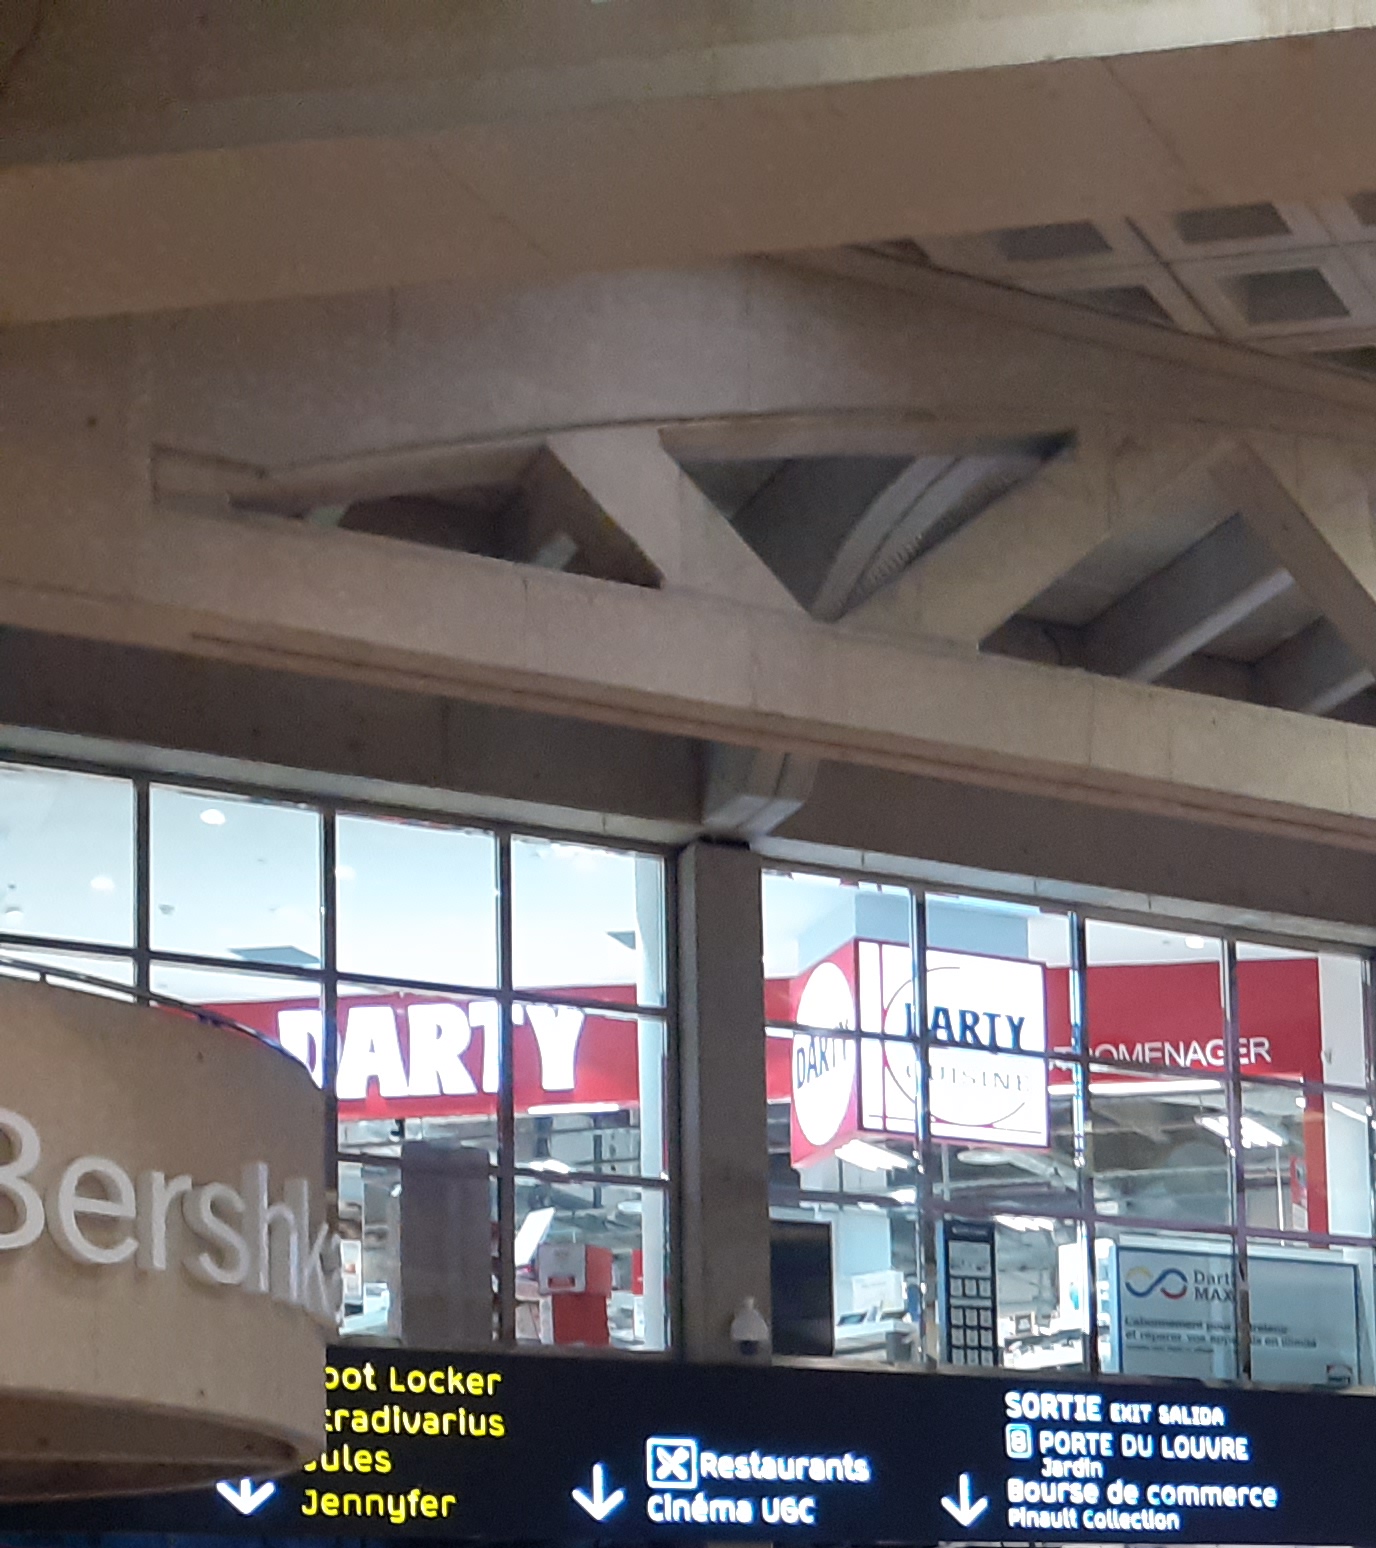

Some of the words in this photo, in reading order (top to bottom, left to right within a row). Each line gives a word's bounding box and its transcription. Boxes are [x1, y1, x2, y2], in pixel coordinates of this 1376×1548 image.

[277, 1000, 585, 1100] DARTY
[1194, 1269, 1233, 1285] Dart
[1194, 1286, 1236, 1301] MAX
[324, 1361, 377, 1391] oot
[389, 1365, 502, 1396] Locker
[324, 1404, 506, 1437] radivarius
[1004, 1391, 1102, 1422] SORTIE
[1110, 1402, 1152, 1424] EXIT
[1158, 1404, 1225, 1427] SALIDA
[303, 1443, 393, 1473] ules
[1039, 1430, 1113, 1457] PORTE
[1121, 1433, 1153, 1458] DU
[1160, 1434, 1250, 1461] LOUVRE
[700, 1450, 871, 1483] Restaurants
[1041, 1456, 1104, 1478] Jardin
[301, 1488, 457, 1524] Jennyfer
[646, 1491, 754, 1524] Cinéma
[761, 1495, 817, 1525] UGC
[1006, 1478, 1100, 1505] Bourse
[1106, 1479, 1140, 1505] de
[1146, 1483, 1279, 1508] commerce
[1007, 1506, 1078, 1529] Pinault
[1082, 1509, 1181, 1531] Collection
